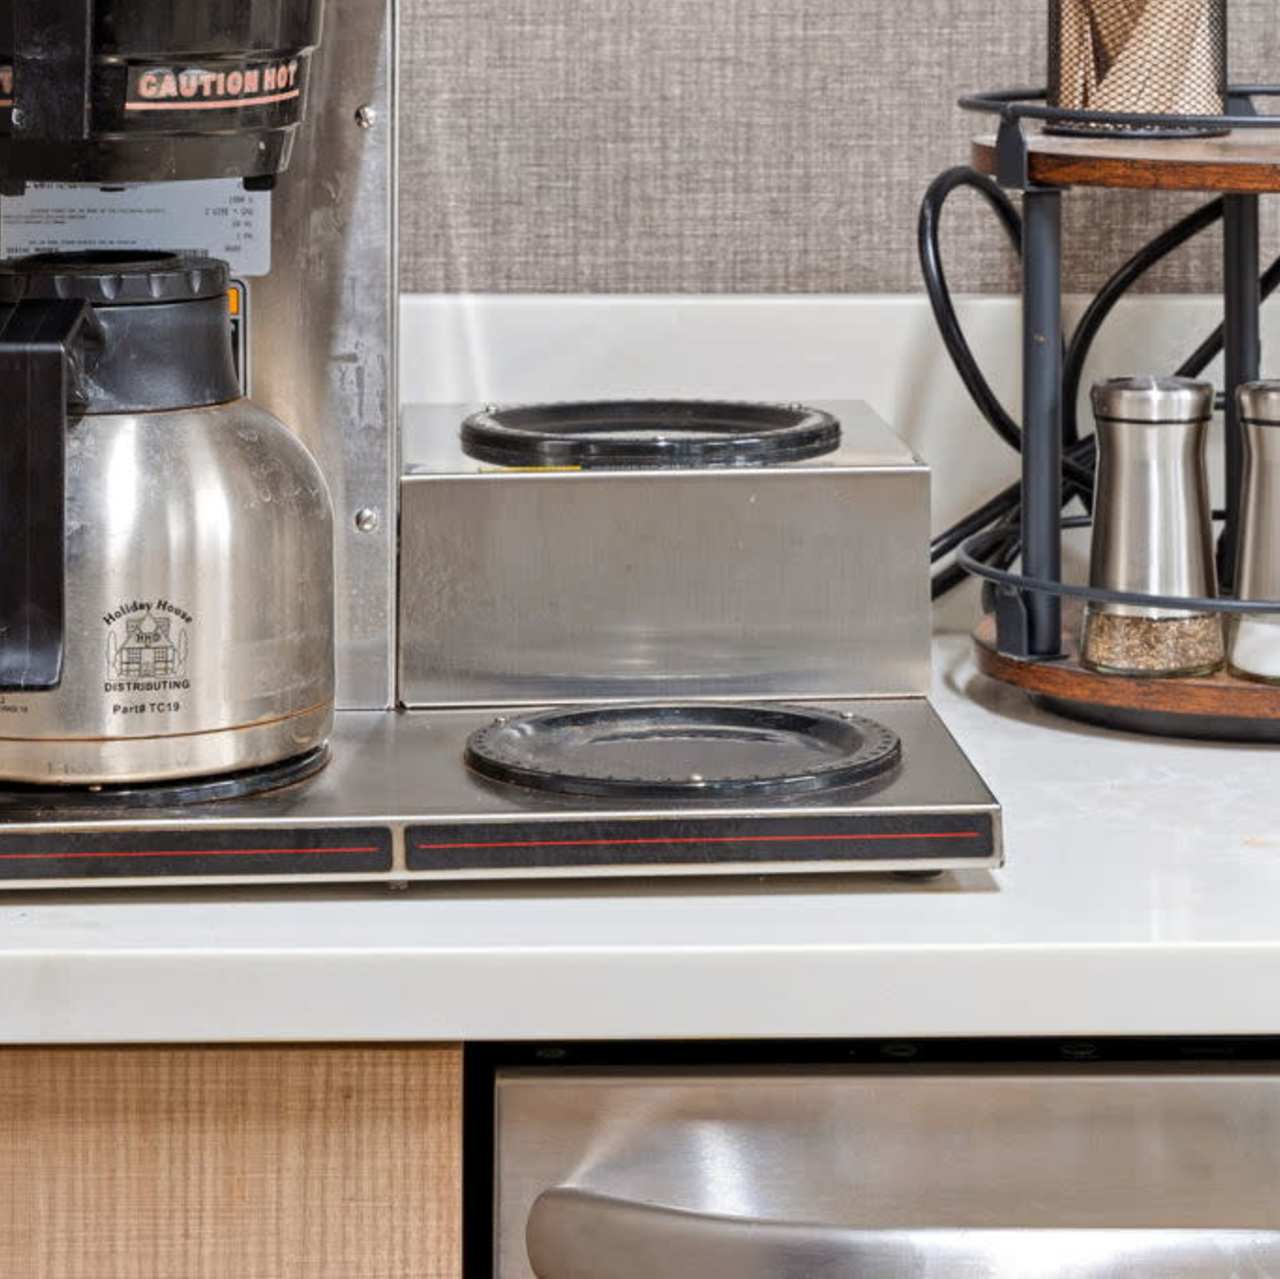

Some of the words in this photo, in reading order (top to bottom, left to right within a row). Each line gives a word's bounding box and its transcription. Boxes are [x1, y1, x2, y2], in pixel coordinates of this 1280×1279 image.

[138, 68, 260, 100] CAUTION
[263, 58, 298, 92] HOT
[103, 600, 152, 626] Holiday
[156, 600, 193, 624] House
[104, 679, 190, 693] DISTRIBUTING
